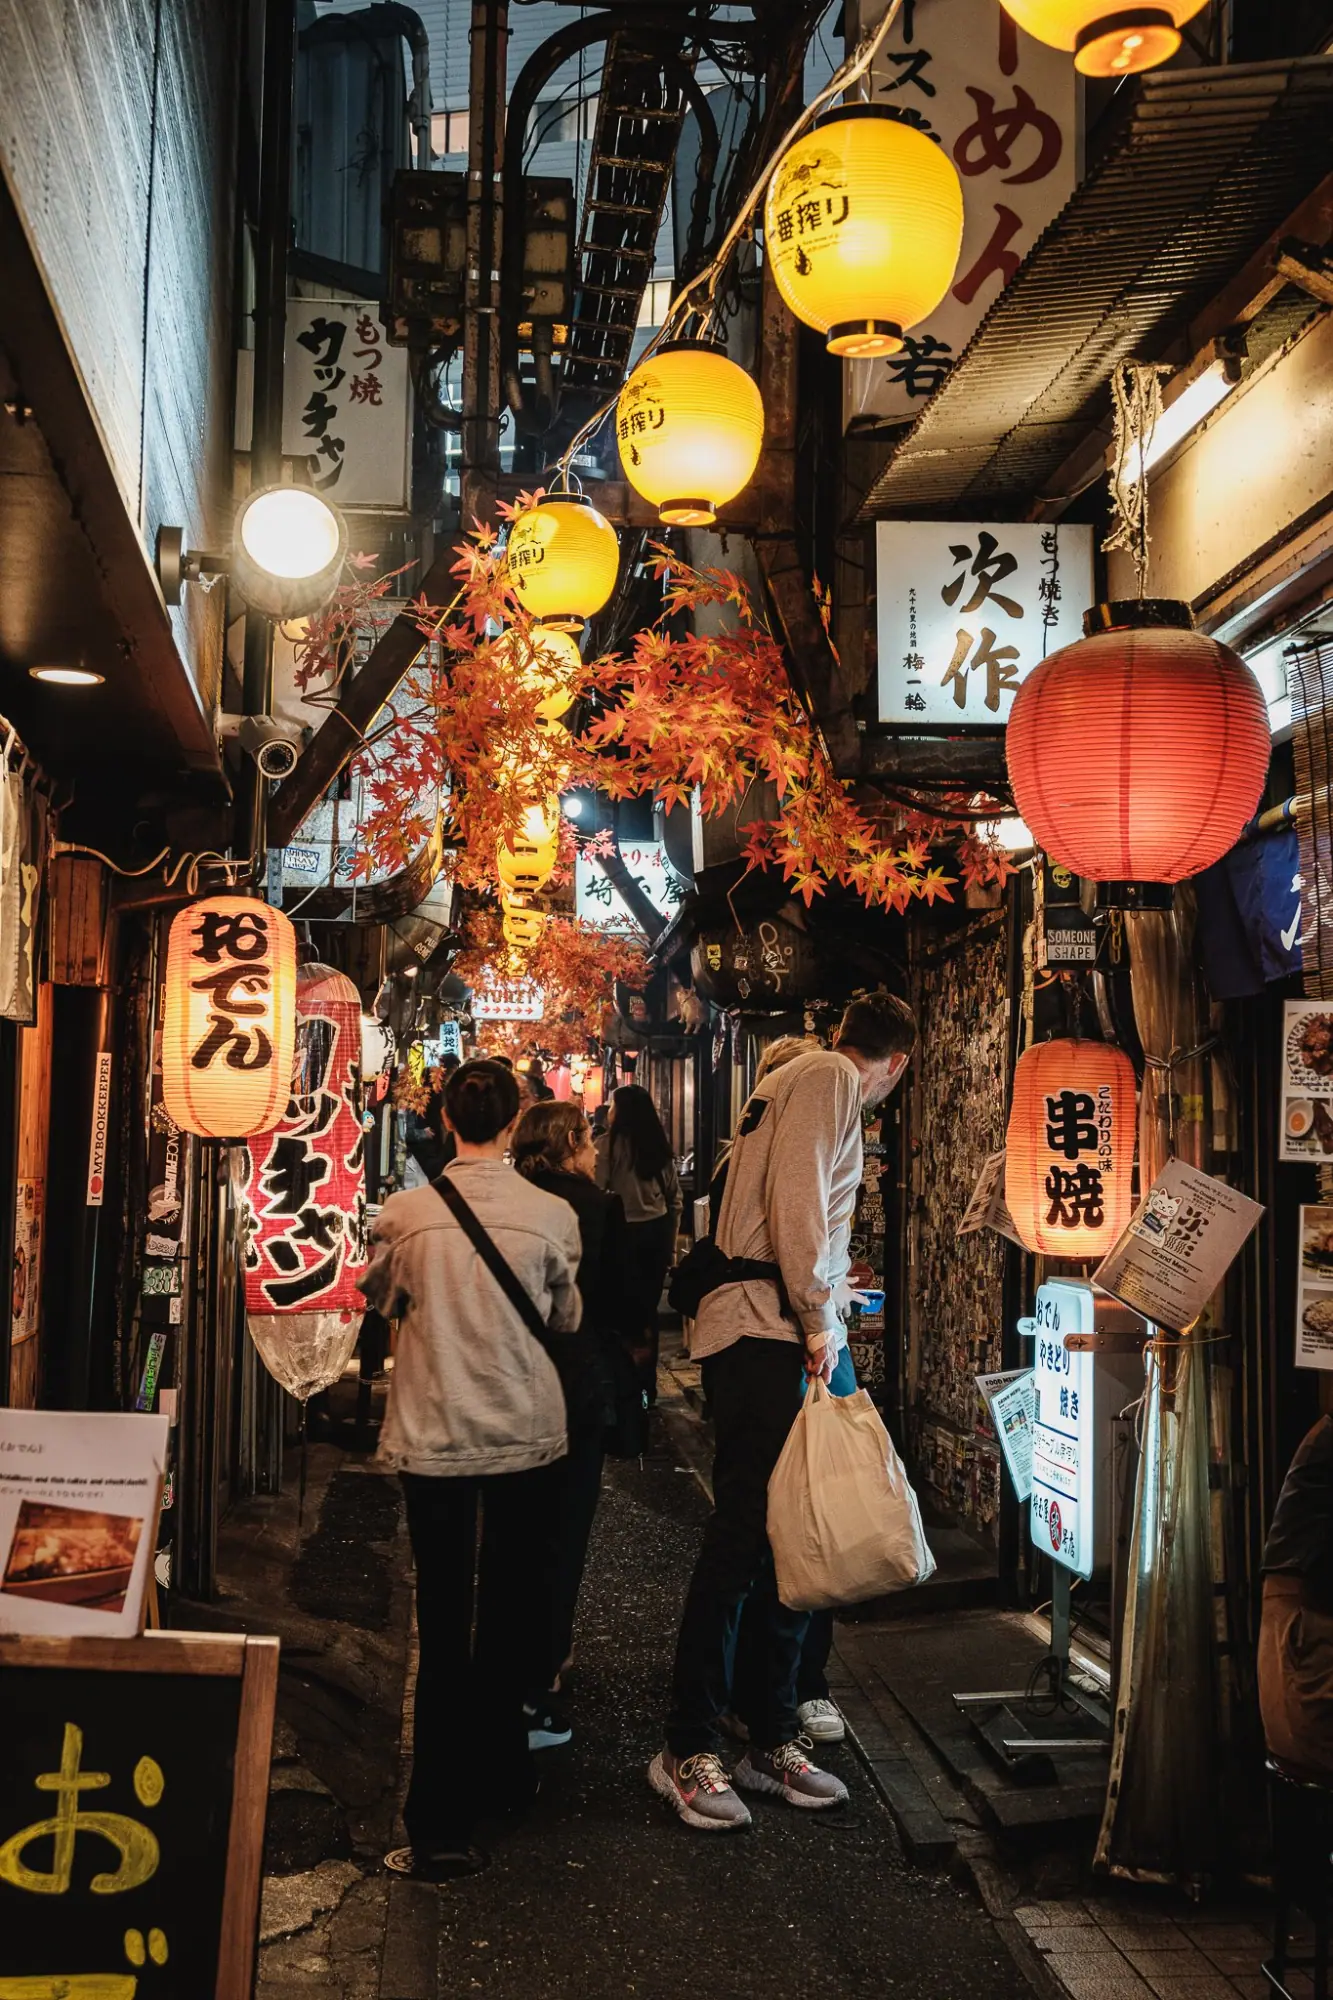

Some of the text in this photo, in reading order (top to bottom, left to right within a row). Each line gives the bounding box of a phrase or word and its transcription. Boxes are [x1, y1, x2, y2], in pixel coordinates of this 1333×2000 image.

[297, 317, 347, 491] ウッチャン
[349, 314, 383, 406] もつ焼
[886, 334, 953, 398] 若
[941, 531, 1024, 713] 次作
[1038, 531, 1062, 626] もつ焼き
[903, 653, 926, 711] 梅一輪
[1048, 930, 1096, 944] SOMEONE
[1055, 946, 1091, 959] SHAPE
[191, 912, 273, 1070] おでん
[95, 1057, 110, 1151] BOOKKEEPER
[1098, 1086, 1113, 1172] こだわりの味
[93, 1151, 104, 1175] MY
[1046, 1090, 1104, 1228] 串焼
[1151, 1248, 1190, 1273] Grand Menu
